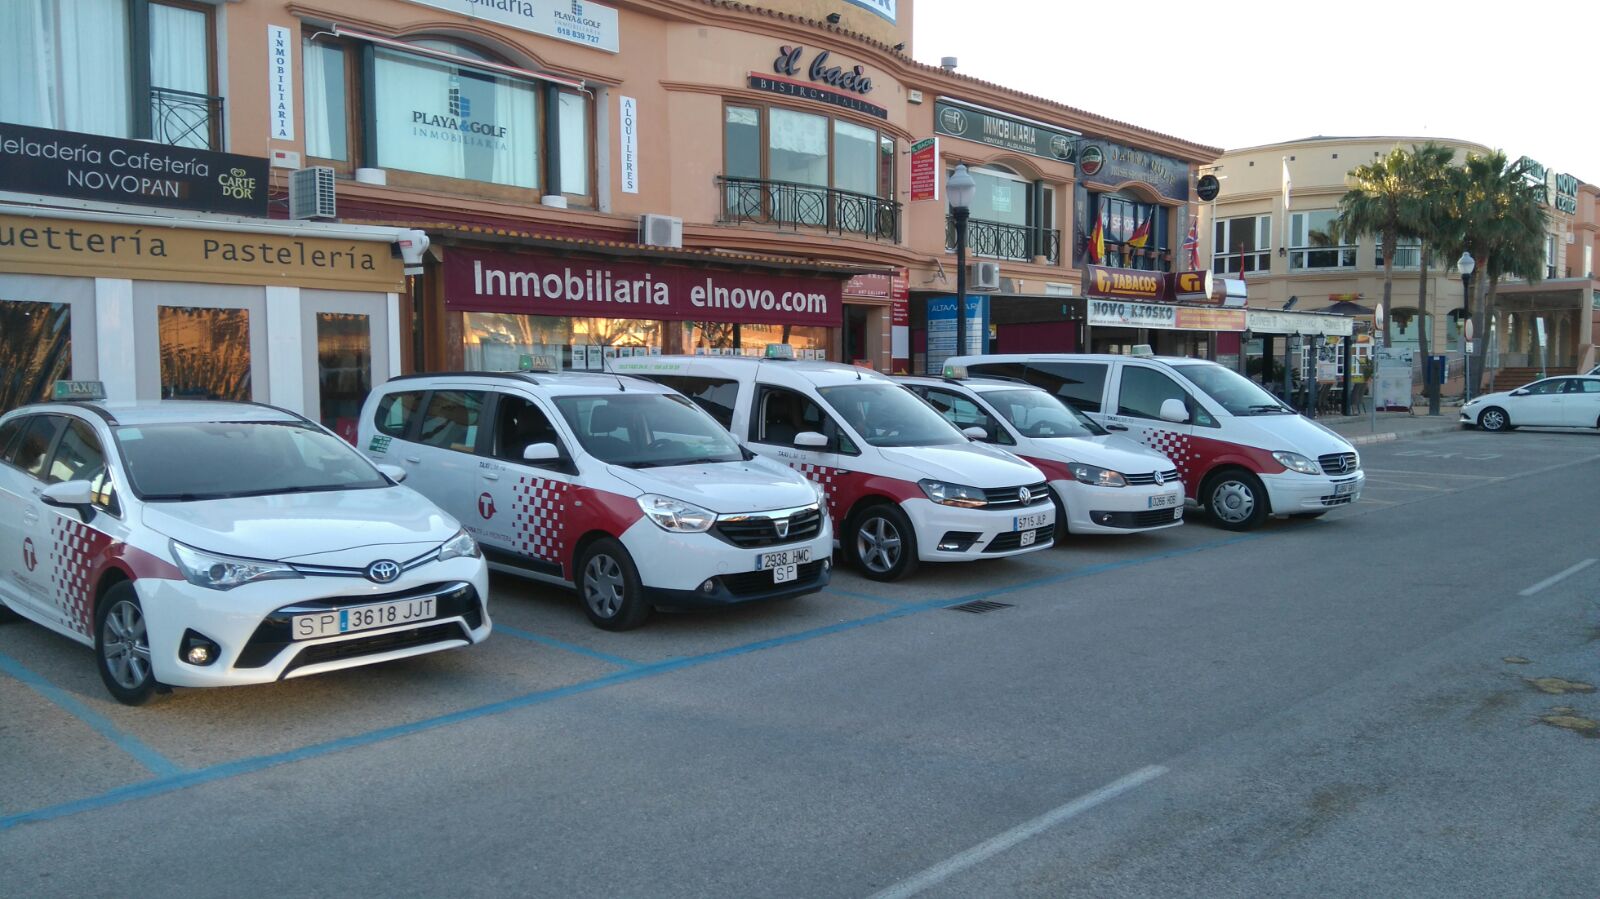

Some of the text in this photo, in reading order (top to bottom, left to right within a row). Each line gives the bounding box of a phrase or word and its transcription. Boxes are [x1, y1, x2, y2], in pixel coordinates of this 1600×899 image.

[276, 30, 287, 137] INMOBILIARIA
[809, 50, 873, 94] bacio
[760, 79, 817, 98] BISTRO
[413, 127, 508, 150] INMOBILIARIA
[983, 114, 1036, 145] INMOBILIARIA
[0, 135, 209, 177] eladería Cafetería
[624, 100, 634, 189] ALQUILERES
[67, 169, 179, 198] NOVOPAN
[218, 173, 256, 190] CARTE
[222, 184, 253, 200] D'OR
[203, 239, 375, 270] Pastelería
[474, 260, 828, 314] Inmobiliaria elnovo.com
[1112, 273, 1157, 292] TABACOS
[1093, 302, 1125, 317] NOVO
[1131, 304, 1173, 320] KIOSKO
[1022, 531, 1036, 545] SP
[764, 548, 809, 569] 2938 HMC
[776, 565, 795, 581] SP
[299, 600, 433, 636] SP 3618 JJT
